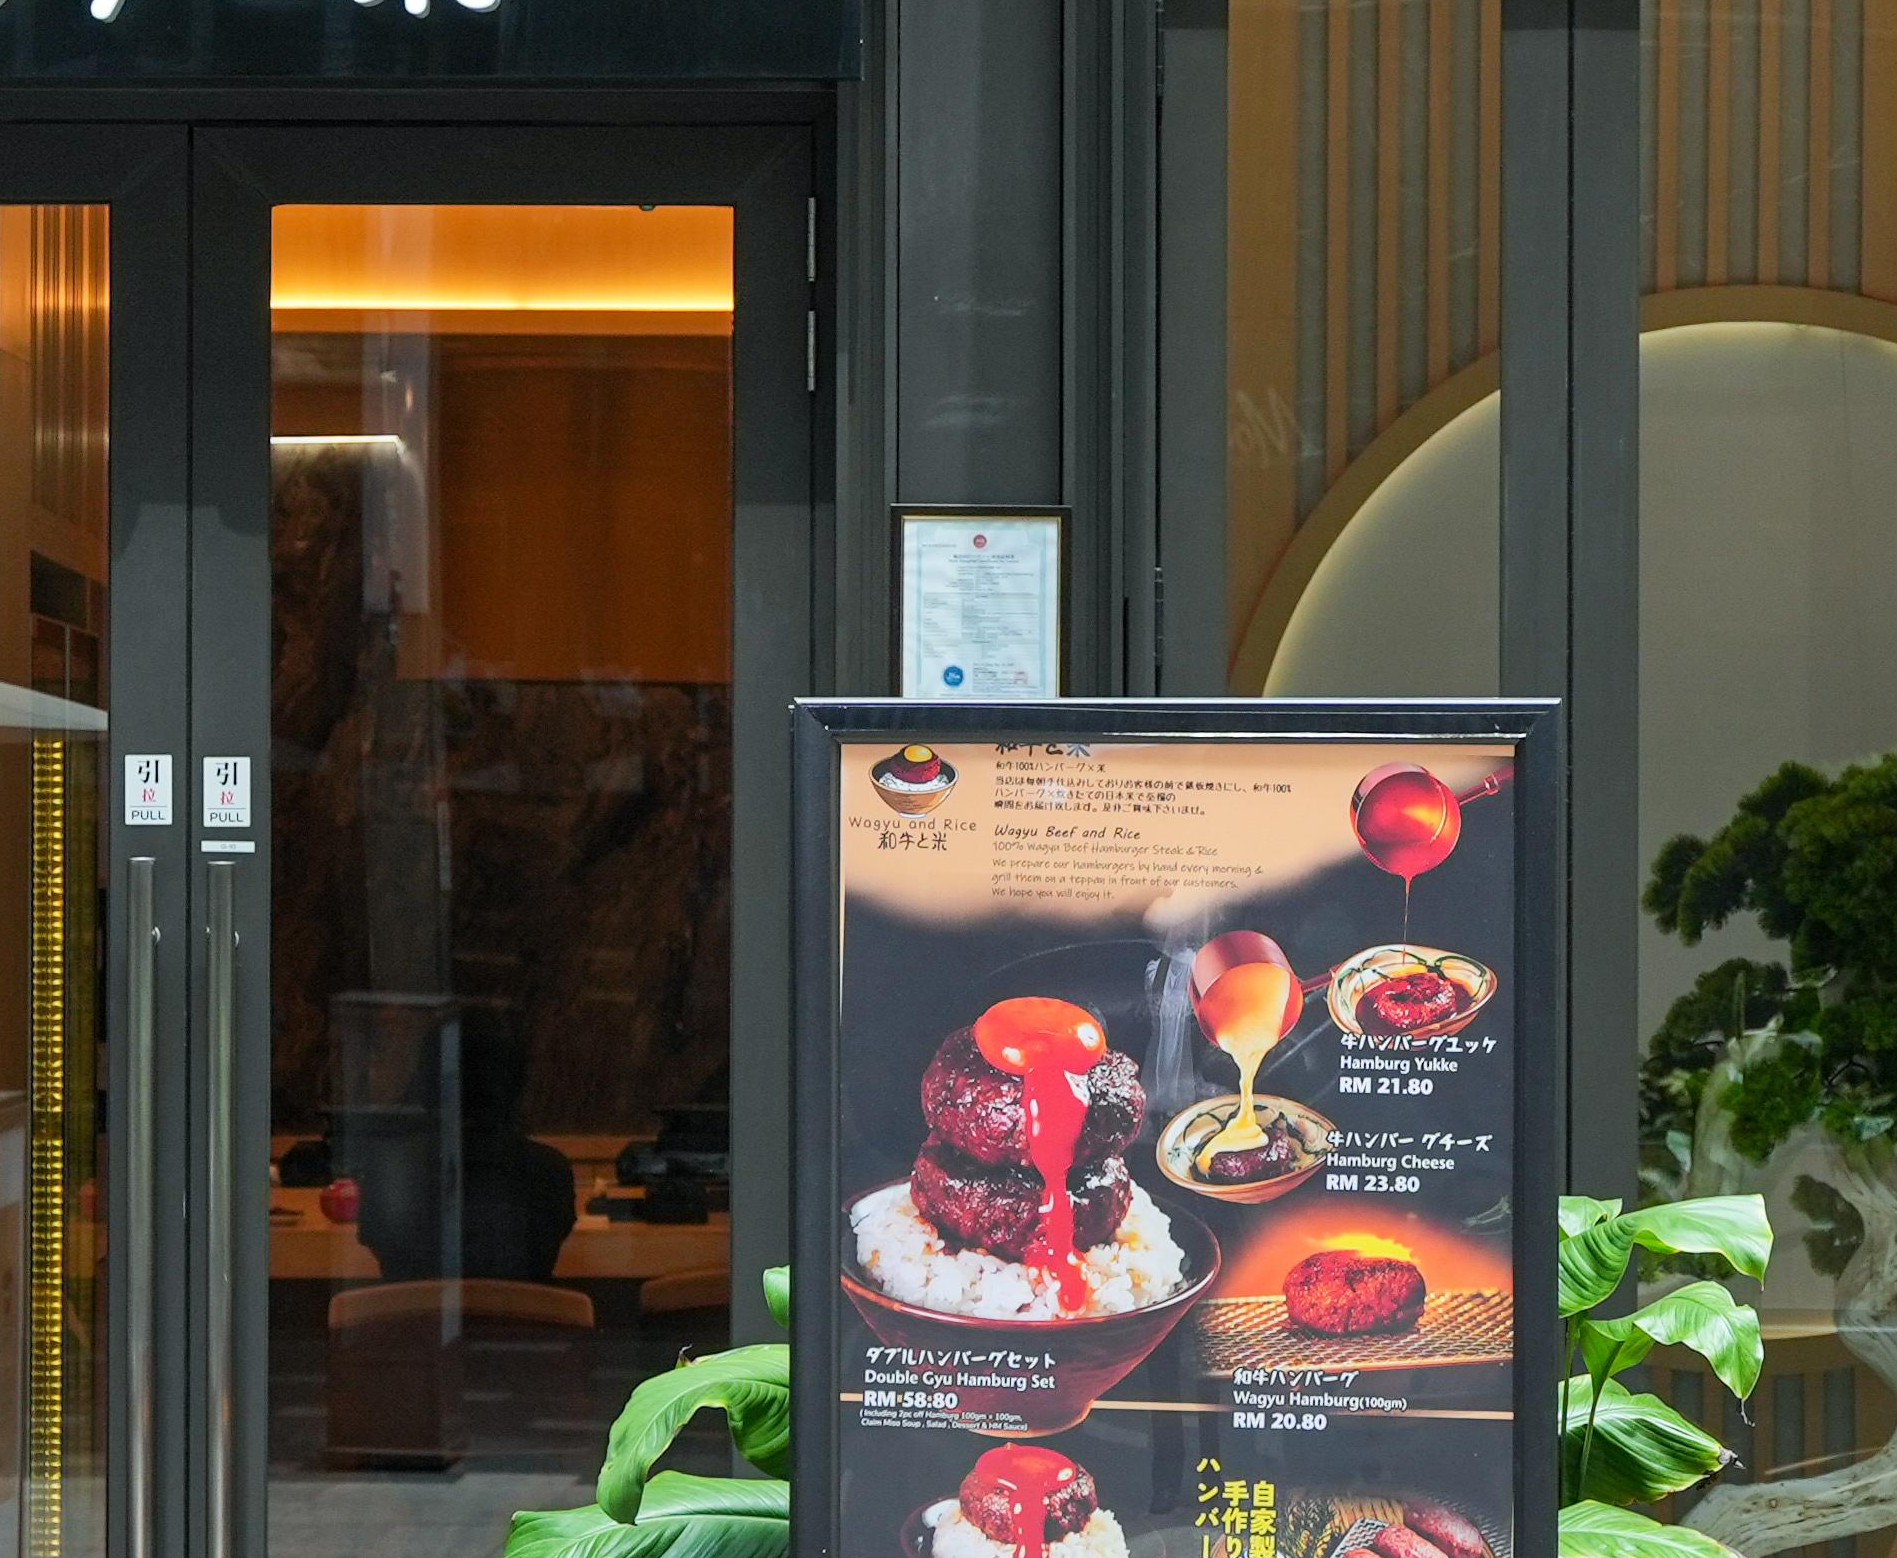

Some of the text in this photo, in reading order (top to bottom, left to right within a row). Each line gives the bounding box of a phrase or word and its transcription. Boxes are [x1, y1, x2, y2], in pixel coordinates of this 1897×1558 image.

[131, 810, 166, 820] PULL
[209, 812, 244, 822] PULL
[848, 816, 978, 832] Wagyu and Rice
[994, 825, 1141, 840] Wagyu Beef and Rice
[878, 832, 948, 852] 和牛と米
[1340, 1056, 1458, 1074] Hamburg Yukke
[1339, 1077, 1433, 1095] RM 21.80
[1327, 1153, 1455, 1172] Hamburg Cheese
[1326, 1174, 1420, 1193] RM 23.80
[864, 1369, 1056, 1391] Double Gyu Hamburg Set
[1233, 1367, 1360, 1389] 和牛ハンバーグ
[864, 1390, 896, 1407] RM
[1233, 1391, 1285, 1410] Wagyu
[1233, 1412, 1327, 1431] RM 20.80
